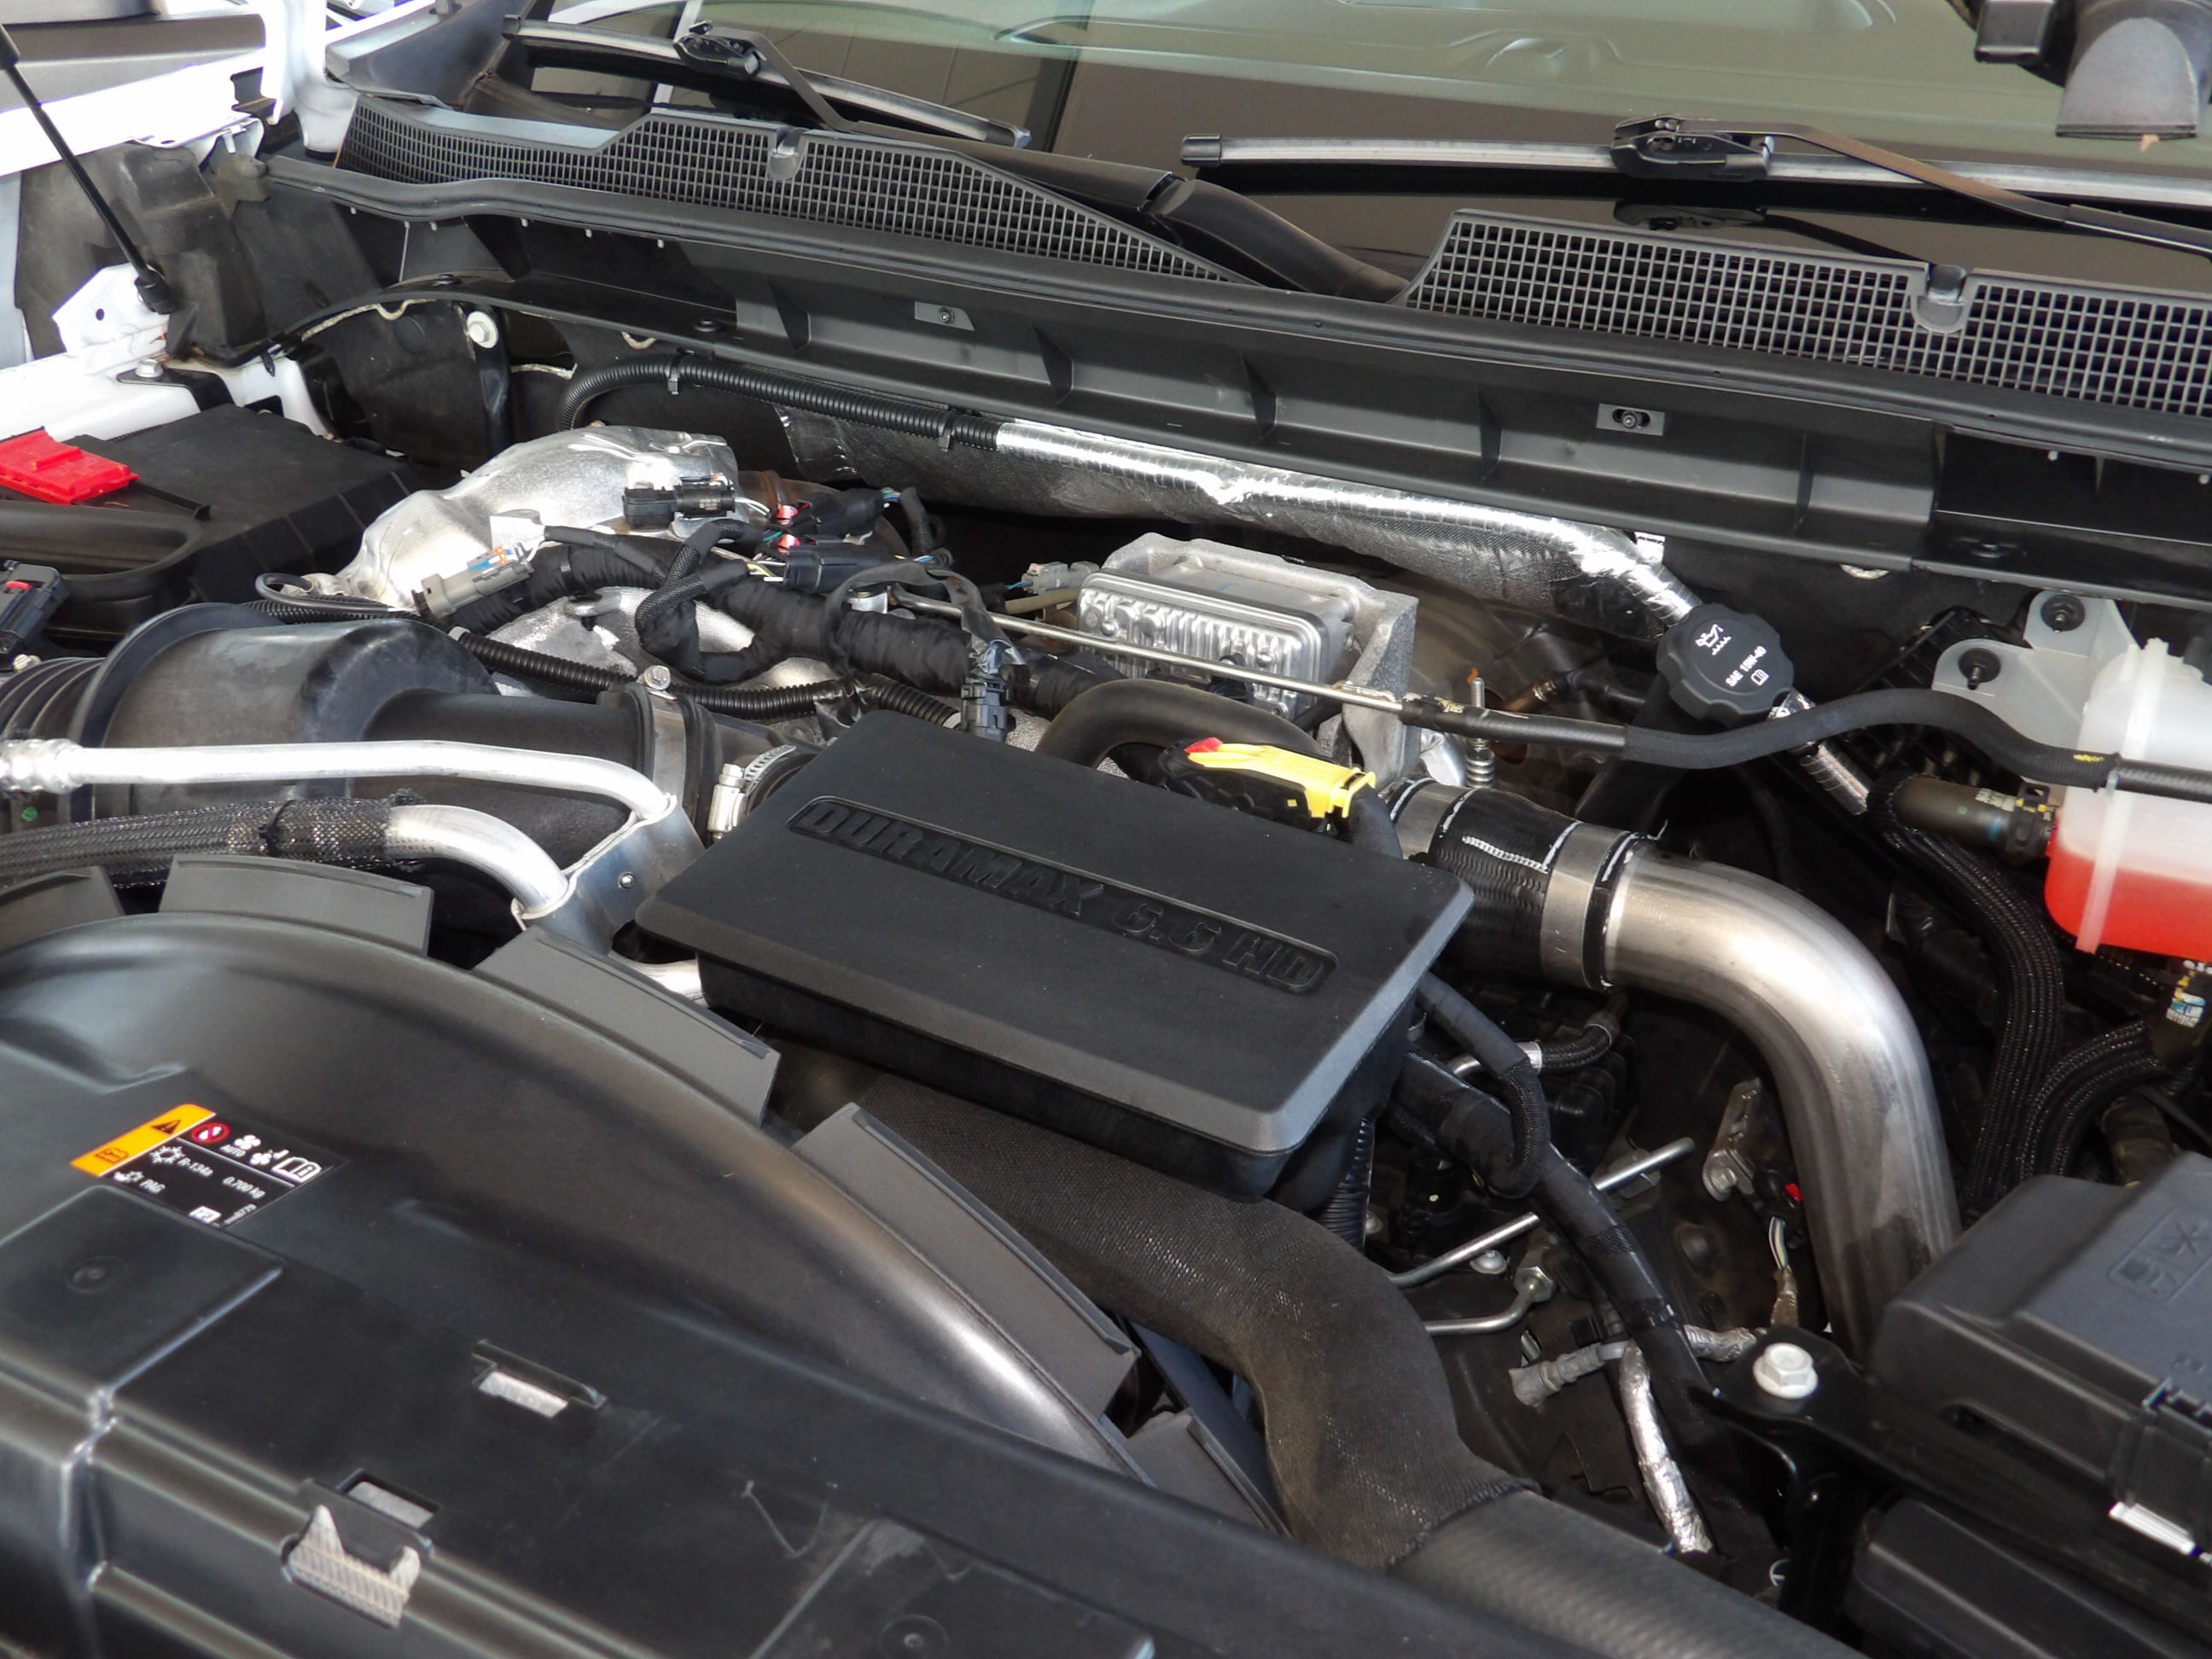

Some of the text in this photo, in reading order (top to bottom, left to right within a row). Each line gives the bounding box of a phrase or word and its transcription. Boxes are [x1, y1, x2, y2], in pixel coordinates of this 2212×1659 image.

[1726, 646, 1767, 687] SAE 15W-40
[794, 800, 1324, 988] DURAMAX 6.6 HD
[219, 1144, 246, 1157] AUTO
[139, 1179, 166, 1194] PAG
[177, 1157, 266, 1199] R-134a 0.700 kg
